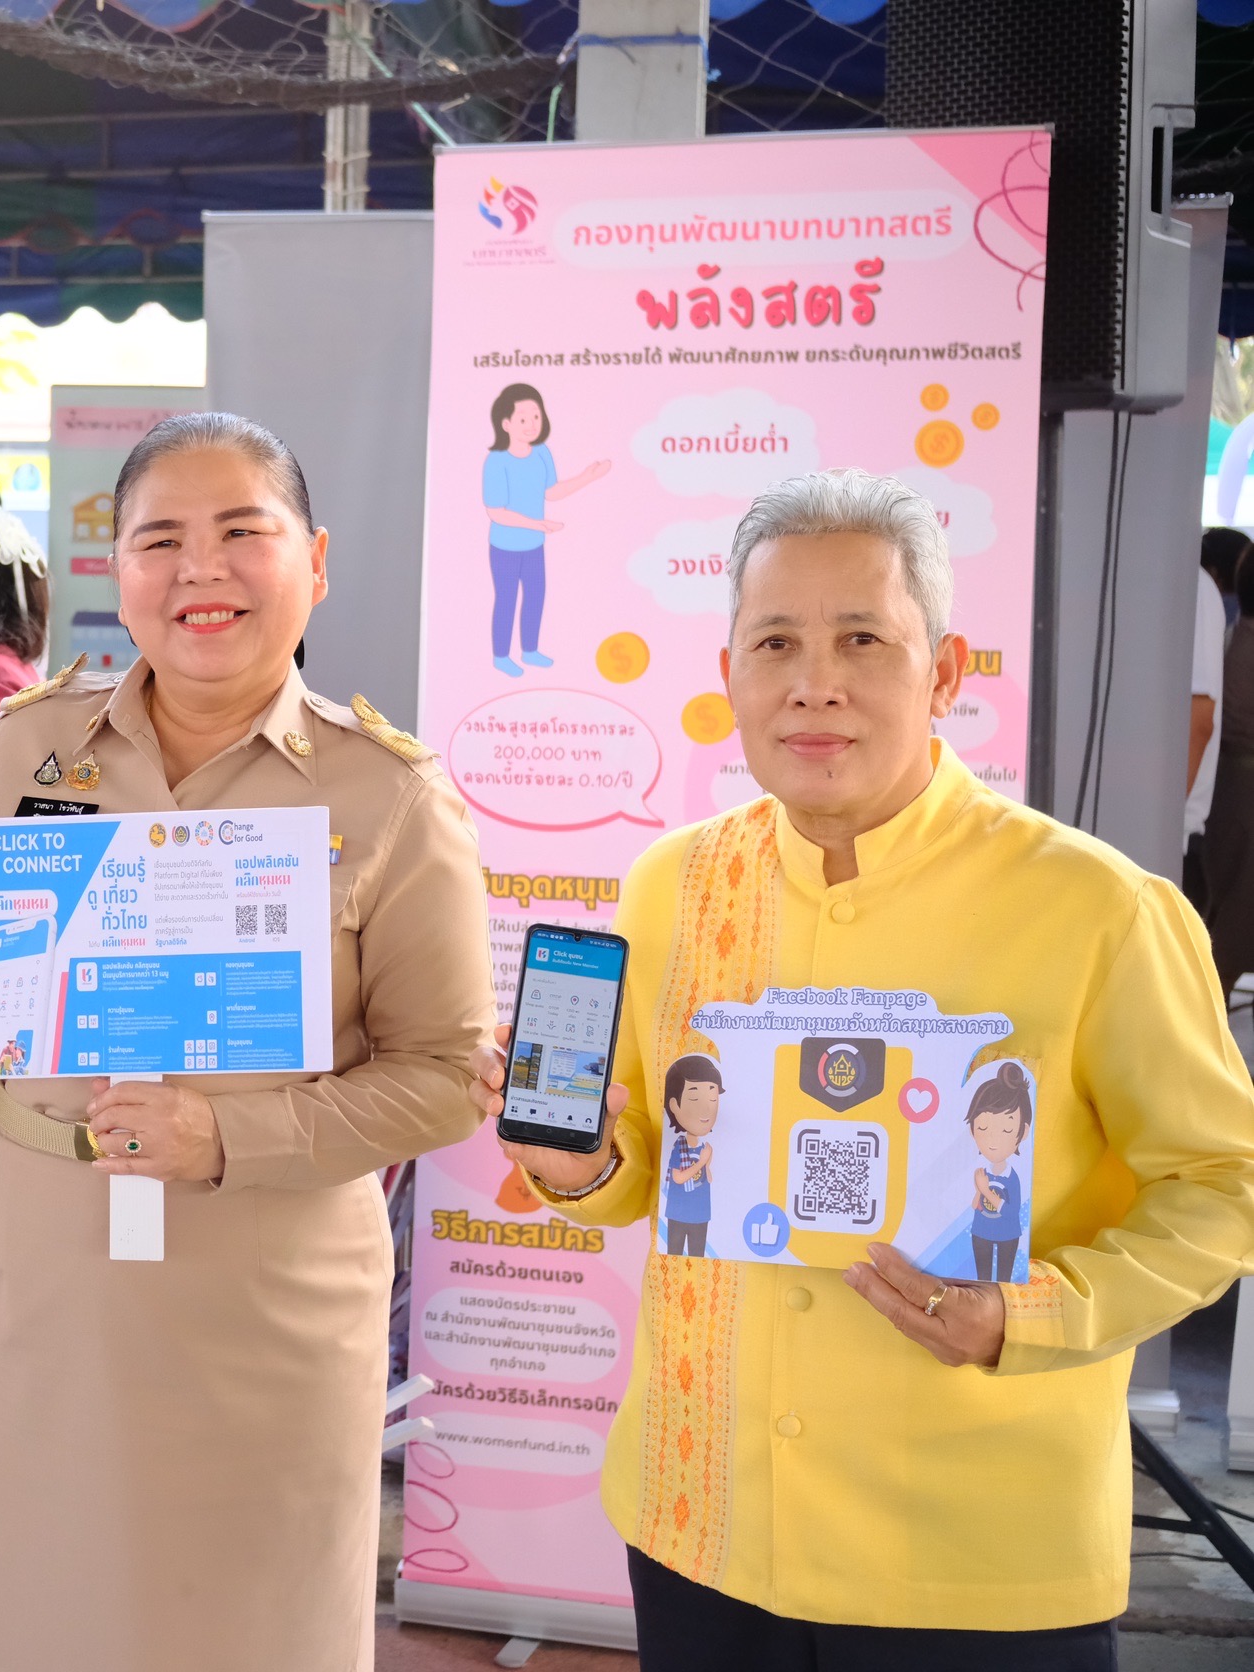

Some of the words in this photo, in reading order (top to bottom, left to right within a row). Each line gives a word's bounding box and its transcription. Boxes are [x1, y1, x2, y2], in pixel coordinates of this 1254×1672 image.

[572, 207, 953, 252] กองทุนพัฒนาบทบาทสตรี
[636, 257, 884, 330] พลังสตรี
[473, 348, 565, 369] เสริมโอกาส
[570, 345, 663, 367] สร้างรายได้
[668, 345, 800, 366] พัฒนาศักยภาพ
[805, 341, 1022, 366] ยกระดับคุณภาพชีวิตสตรี
[660, 422, 789, 455] ดอกเบี้ยต่ำ
[667, 554, 730, 576] วงเงิ
[946, 702, 979, 717] าชีพ
[464, 715, 636, 738] วงเงินสูงสุดโครงการละ
[570, 749, 602, 762] บาท
[463, 761, 574, 786] ดอกเบี้ยร้อยละ
[578, 770, 633, 788] 0.10/ปี
[42, 832, 66, 850] TO
[234, 834, 244, 842] for
[245, 833, 263, 842] Good
[2, 854, 83, 874] CONNECT
[102, 856, 146, 883] เรียนรู้
[235, 854, 300, 870] แอปพลิเคชัน
[154, 871, 179, 880] Platform
[235, 872, 291, 890] คลิกชุมชน
[87, 889, 98, 910] ดู
[103, 878, 138, 904] เที่ยว
[101, 905, 148, 930] ทั่วไทย
[102, 936, 146, 950] คลิกชุมชน
[767, 986, 848, 1006] Facebook
[851, 988, 928, 1011] Fanpage
[690, 1009, 1009, 1038] สำนักงานพัฒนาชุมชนจังหวัดสมุทรสงคราม
[431, 1208, 605, 1253] วิธีการสมัคร
[449, 1258, 585, 1284] สมัครด้วยตนเอง
[459, 1295, 577, 1316] แสดงบัตรประชาชน
[440, 1309, 616, 1339] สำนักงานพัฒนาชุมชนจังหวัด
[427, 1379, 623, 1414] มัครด้วยวิธีอิเล็กทรอนิก
[434, 1430, 592, 1456] www.womenfund.in.th
